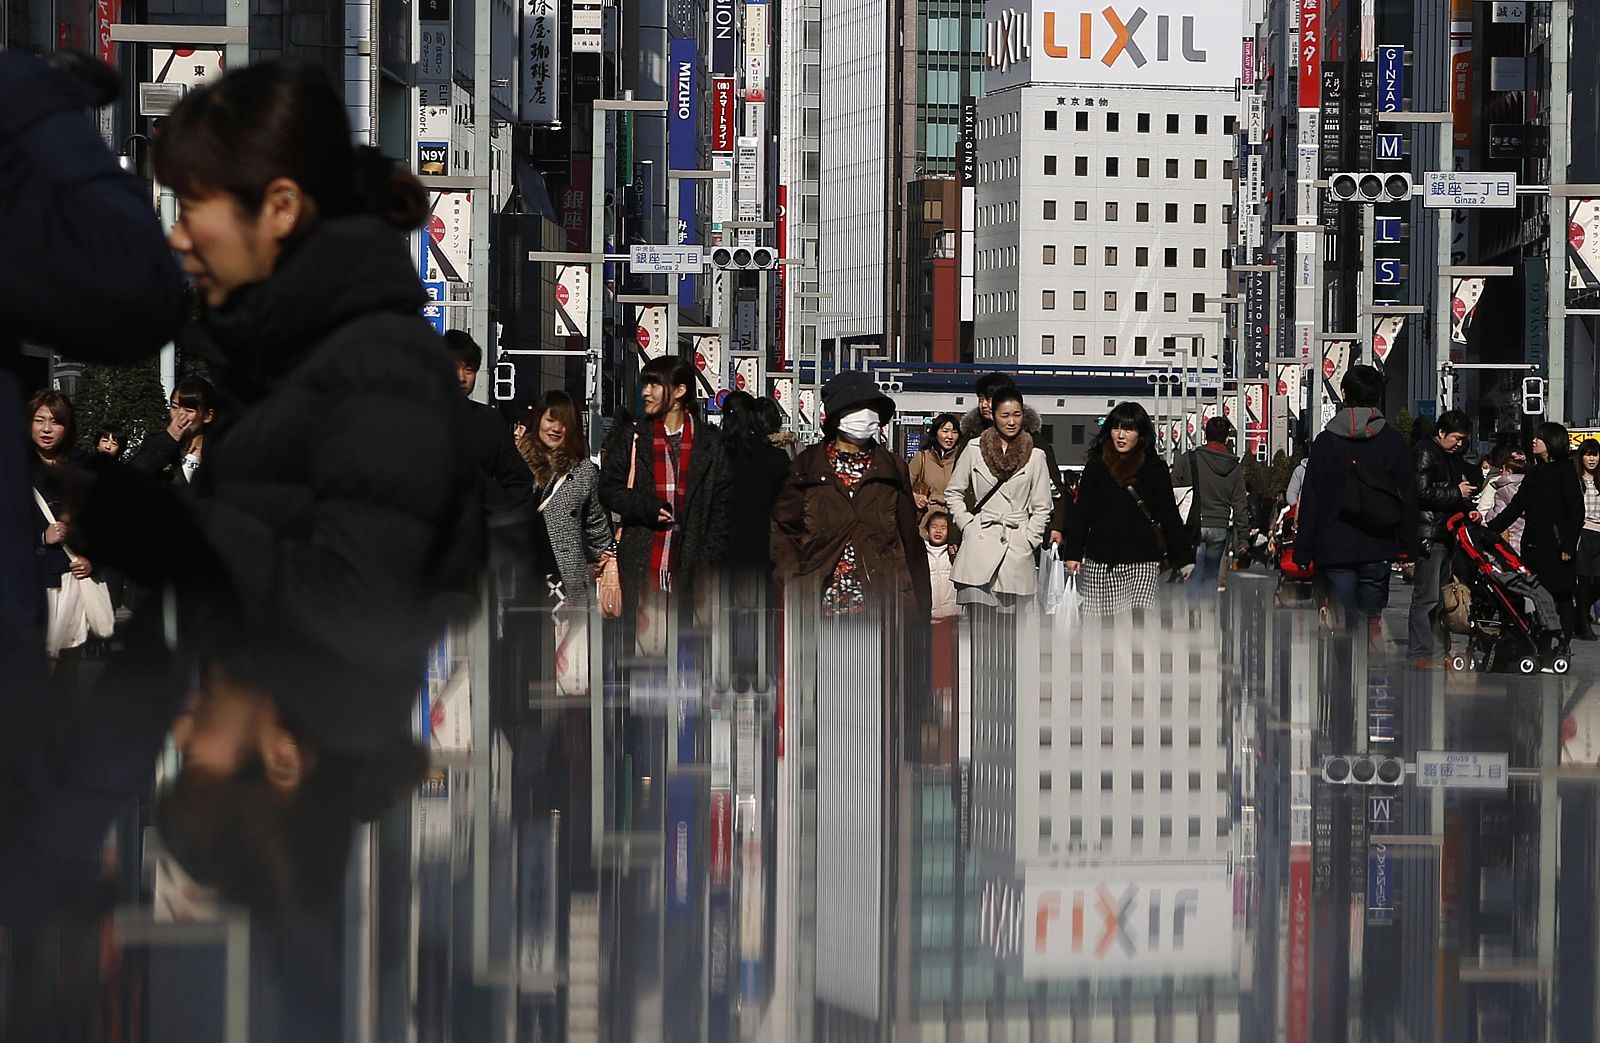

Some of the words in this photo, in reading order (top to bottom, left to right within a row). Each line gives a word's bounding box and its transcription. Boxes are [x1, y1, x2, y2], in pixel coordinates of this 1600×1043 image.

[1043, 6, 1206, 68] LIXIL
[438, 84, 448, 116] ELITE
[679, 62, 691, 119] MIZUHO
[421, 150, 446, 161] N9Y
[1381, 137, 1398, 157] M
[1430, 173, 1456, 181] 中央区
[1431, 182, 1509, 195] 銀座二丁目
[1454, 196, 1477, 205] Ginza
[1480, 196, 1486, 204] 2
[1383, 220, 1394, 240] L
[635, 253, 697, 263] 銀座二丁目
[1382, 262, 1394, 282] S
